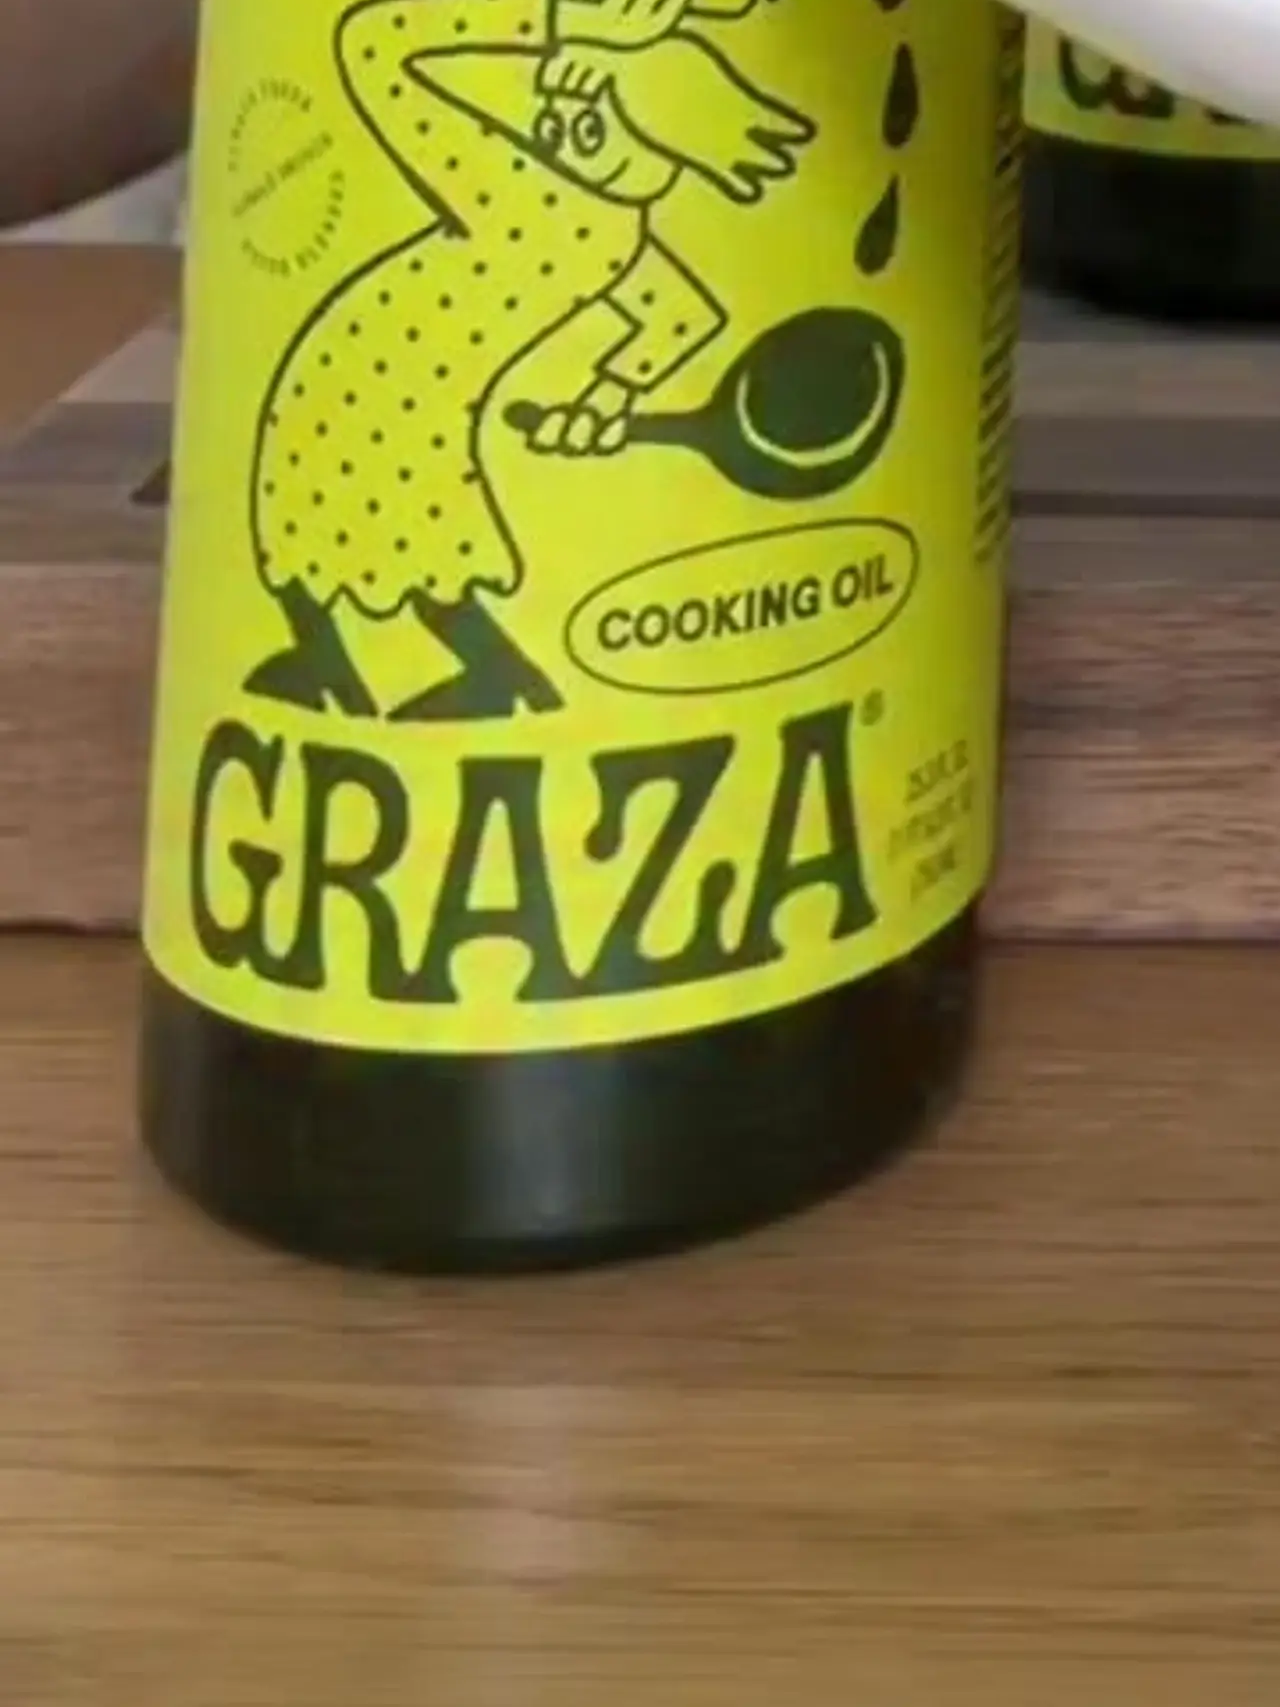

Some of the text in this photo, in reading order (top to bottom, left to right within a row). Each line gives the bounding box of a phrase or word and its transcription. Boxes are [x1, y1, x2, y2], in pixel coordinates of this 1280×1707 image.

[597, 552, 893, 651] COOKING OIL
[190, 699, 877, 1004] GRAZA
